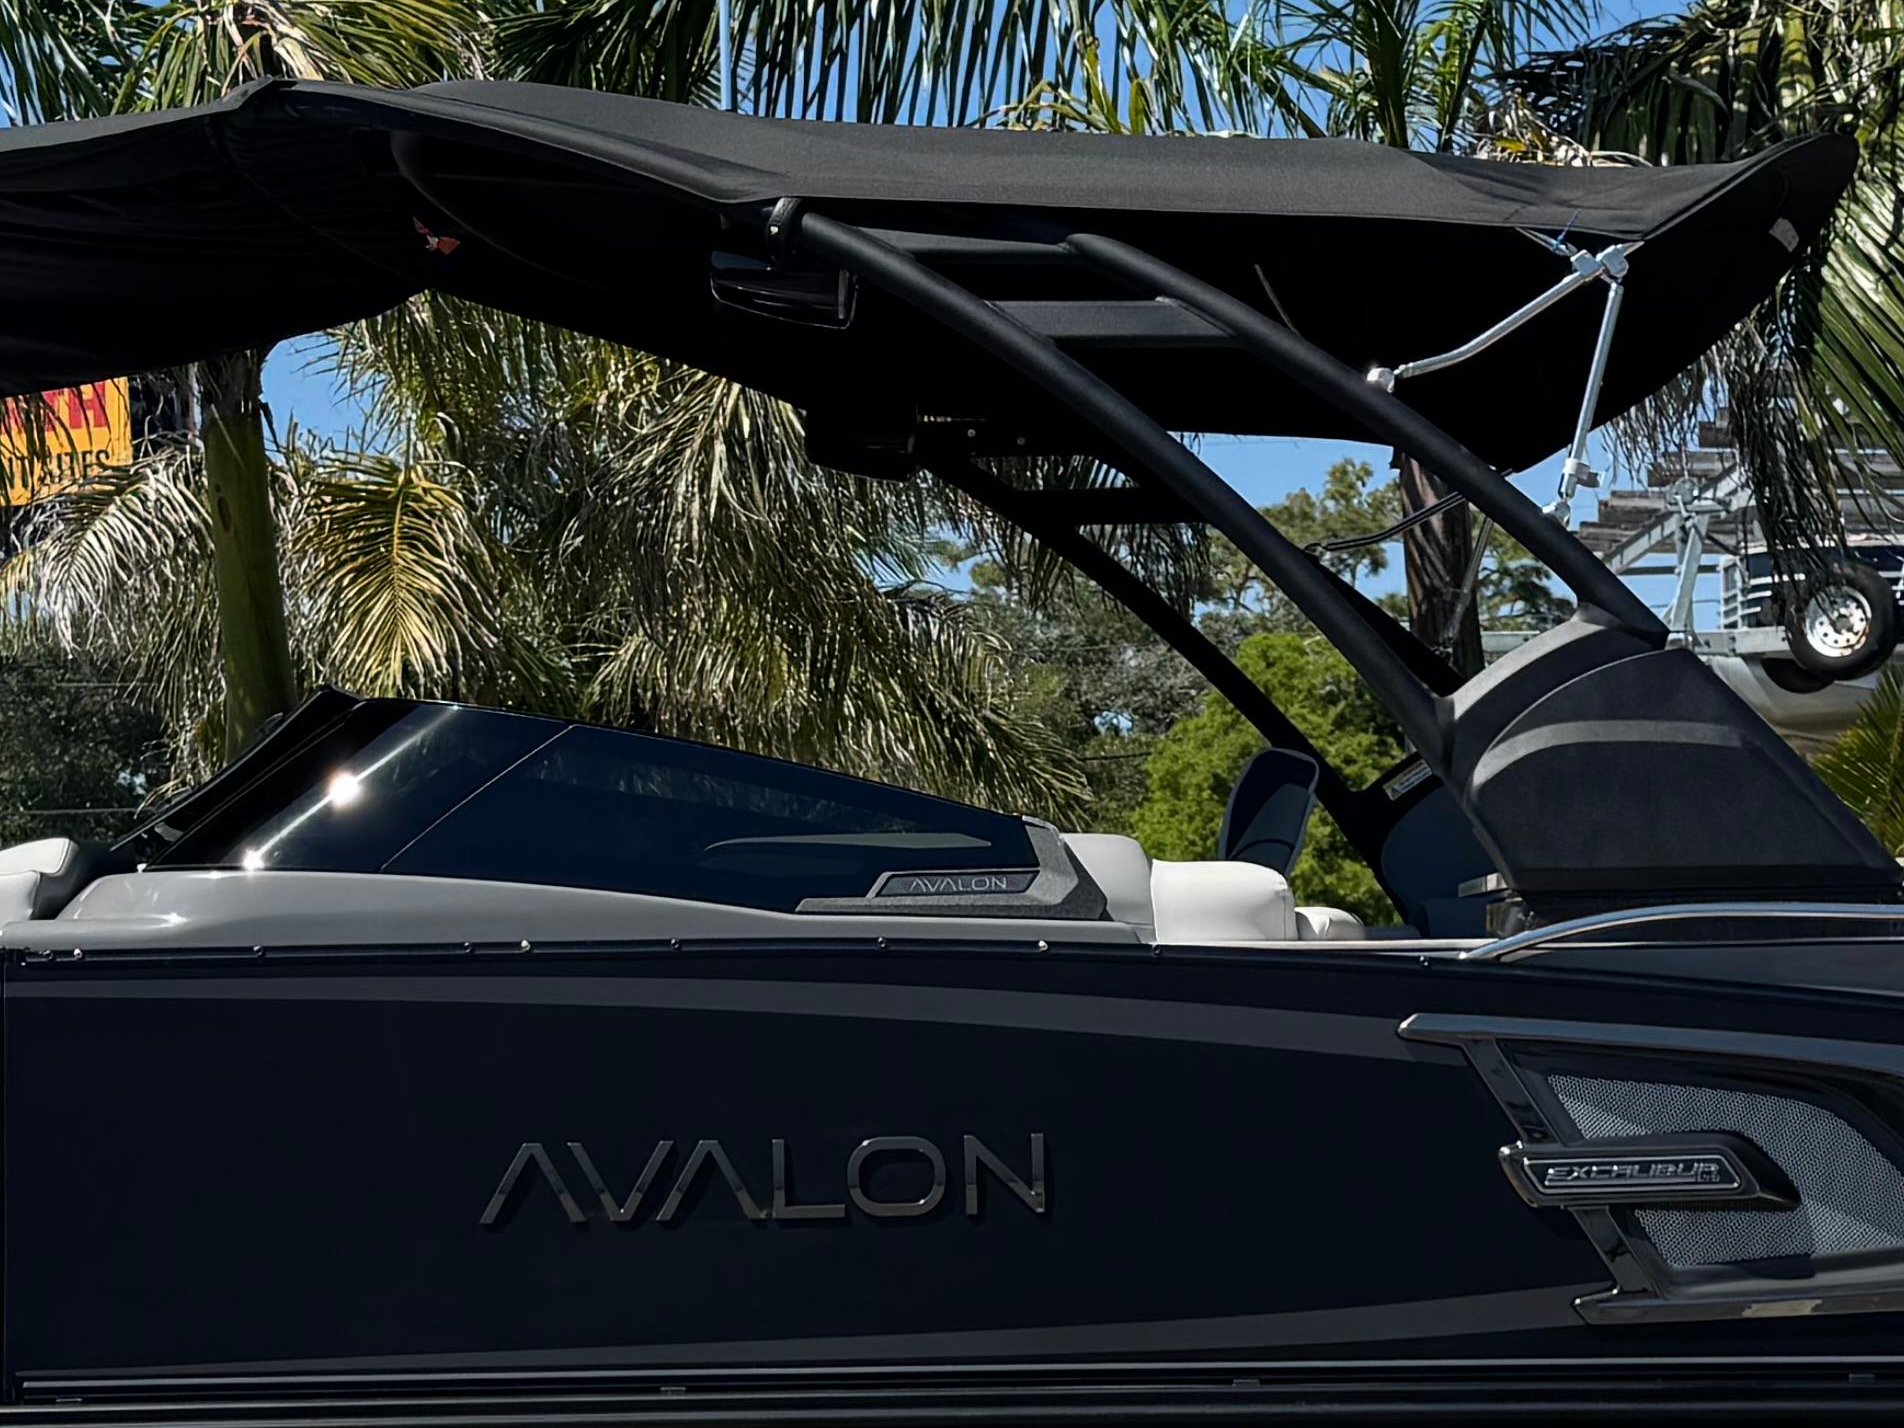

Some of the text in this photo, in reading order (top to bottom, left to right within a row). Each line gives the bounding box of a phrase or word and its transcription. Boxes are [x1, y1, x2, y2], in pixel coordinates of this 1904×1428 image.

[908, 875, 1007, 893] AVALON
[479, 1133, 1046, 1224] AVALON
[1546, 1161, 1720, 1182] EXCALIBUR
